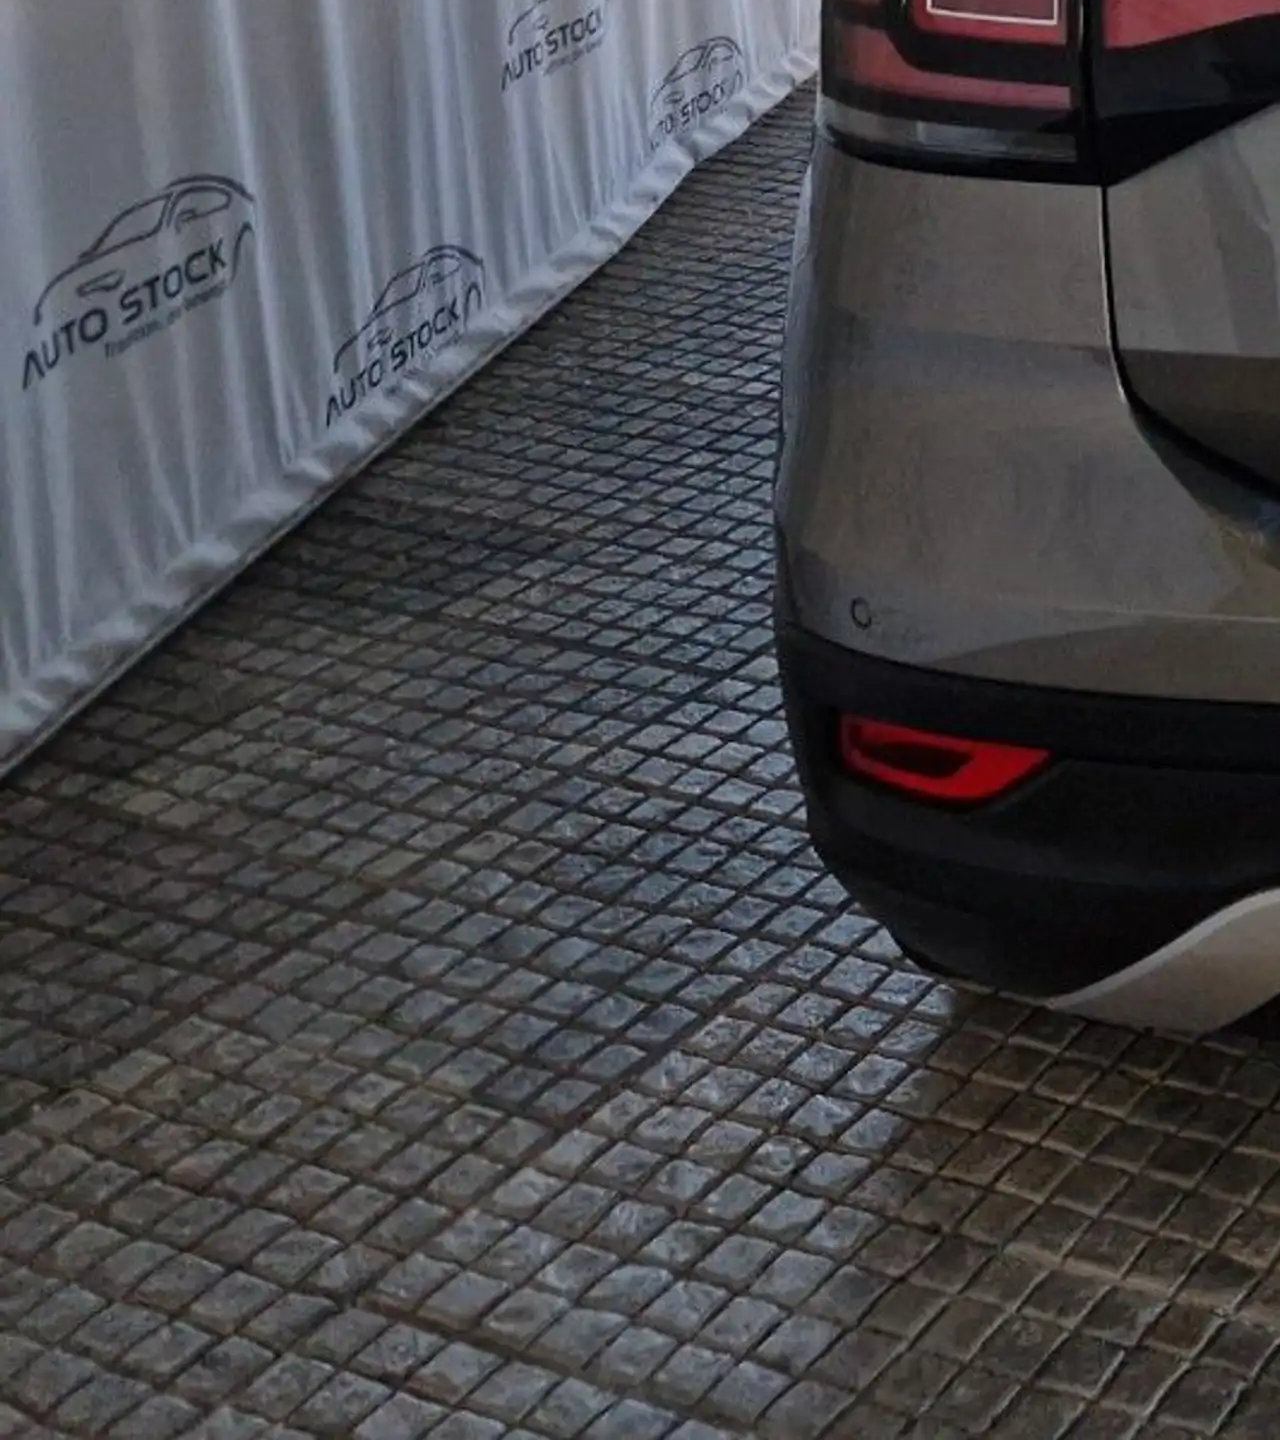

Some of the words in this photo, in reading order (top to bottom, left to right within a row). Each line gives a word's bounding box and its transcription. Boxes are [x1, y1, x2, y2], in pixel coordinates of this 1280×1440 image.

[22, 307, 109, 392] AUTO
[120, 237, 227, 327] STOCK
[326, 360, 385, 429] AUTO
[391, 296, 460, 373] STOCK
